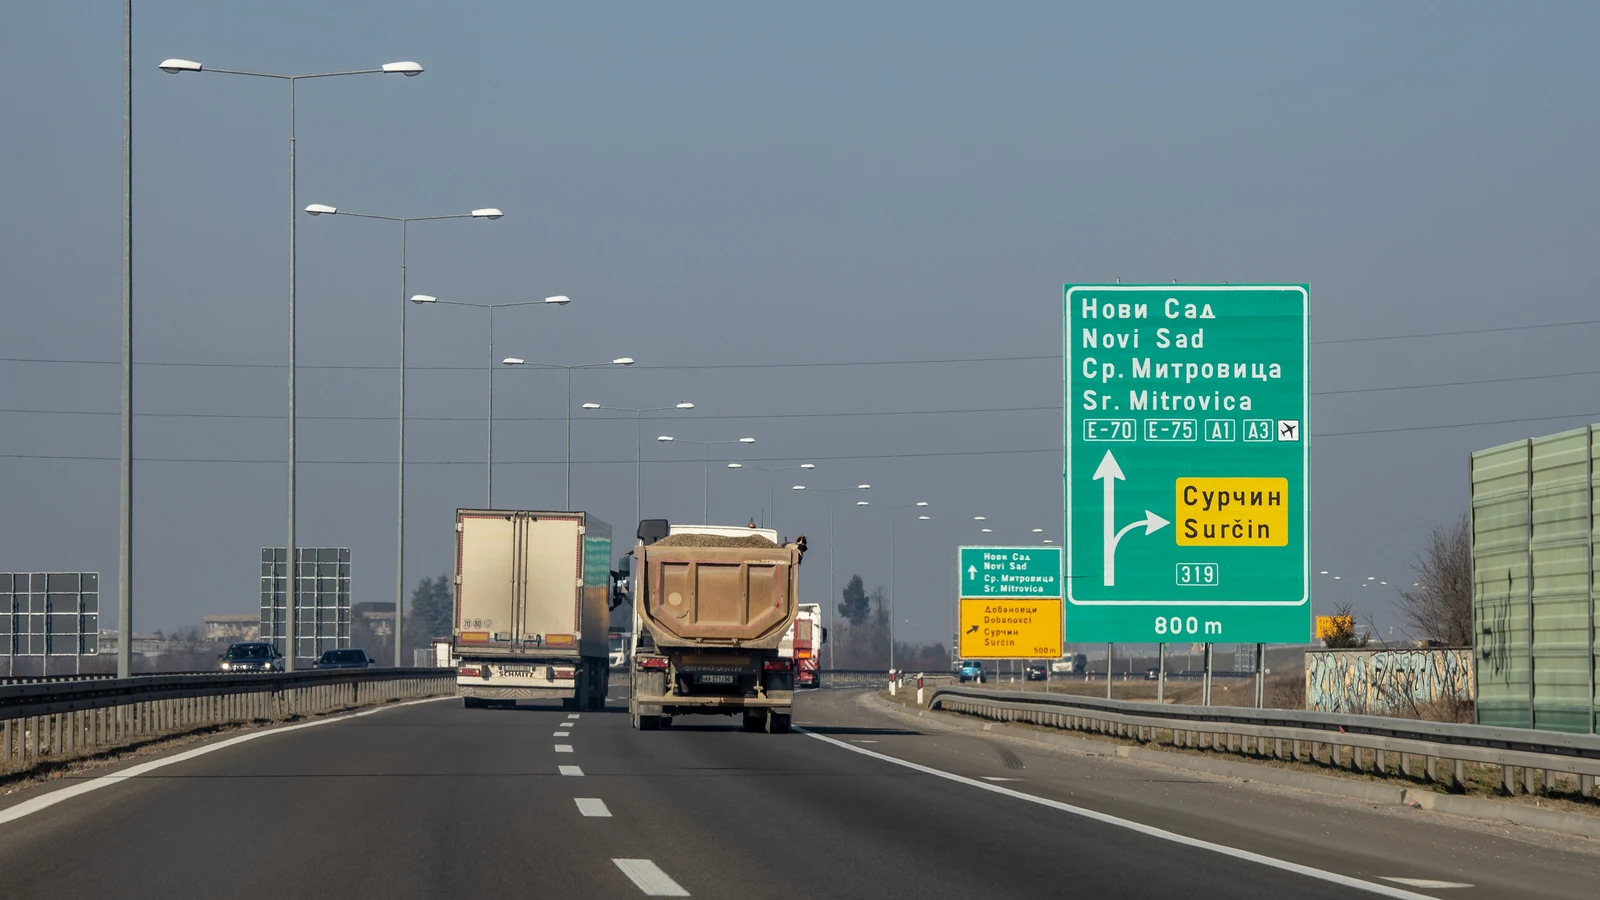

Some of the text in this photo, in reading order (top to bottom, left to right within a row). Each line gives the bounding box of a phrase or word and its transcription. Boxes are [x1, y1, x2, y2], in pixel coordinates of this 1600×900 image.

[1082, 297, 1216, 319] Нови Сад
[1082, 327, 1204, 349] Novi Sad
[1082, 357, 1282, 384] Ср. Митровица
[1083, 389, 1252, 411] Sr. Mitrovica
[1088, 421, 1269, 439] E-70 E-75 A1 A3
[1183, 485, 1281, 511] Сурчин
[1184, 517, 1270, 539] Surčin
[983, 552, 1031, 561] Нови Сад
[983, 562, 1027, 570] Novi Sad
[1181, 565, 1214, 583] 319
[984, 574, 1054, 583] Ср. Митровица
[984, 585, 1044, 593] Sr. Mitrovica
[984, 606, 1037, 614] Добановци
[984, 616, 1032, 624] Dobanovci
[1154, 616, 1222, 635] 800 m
[984, 628, 1019, 637] Сурчин
